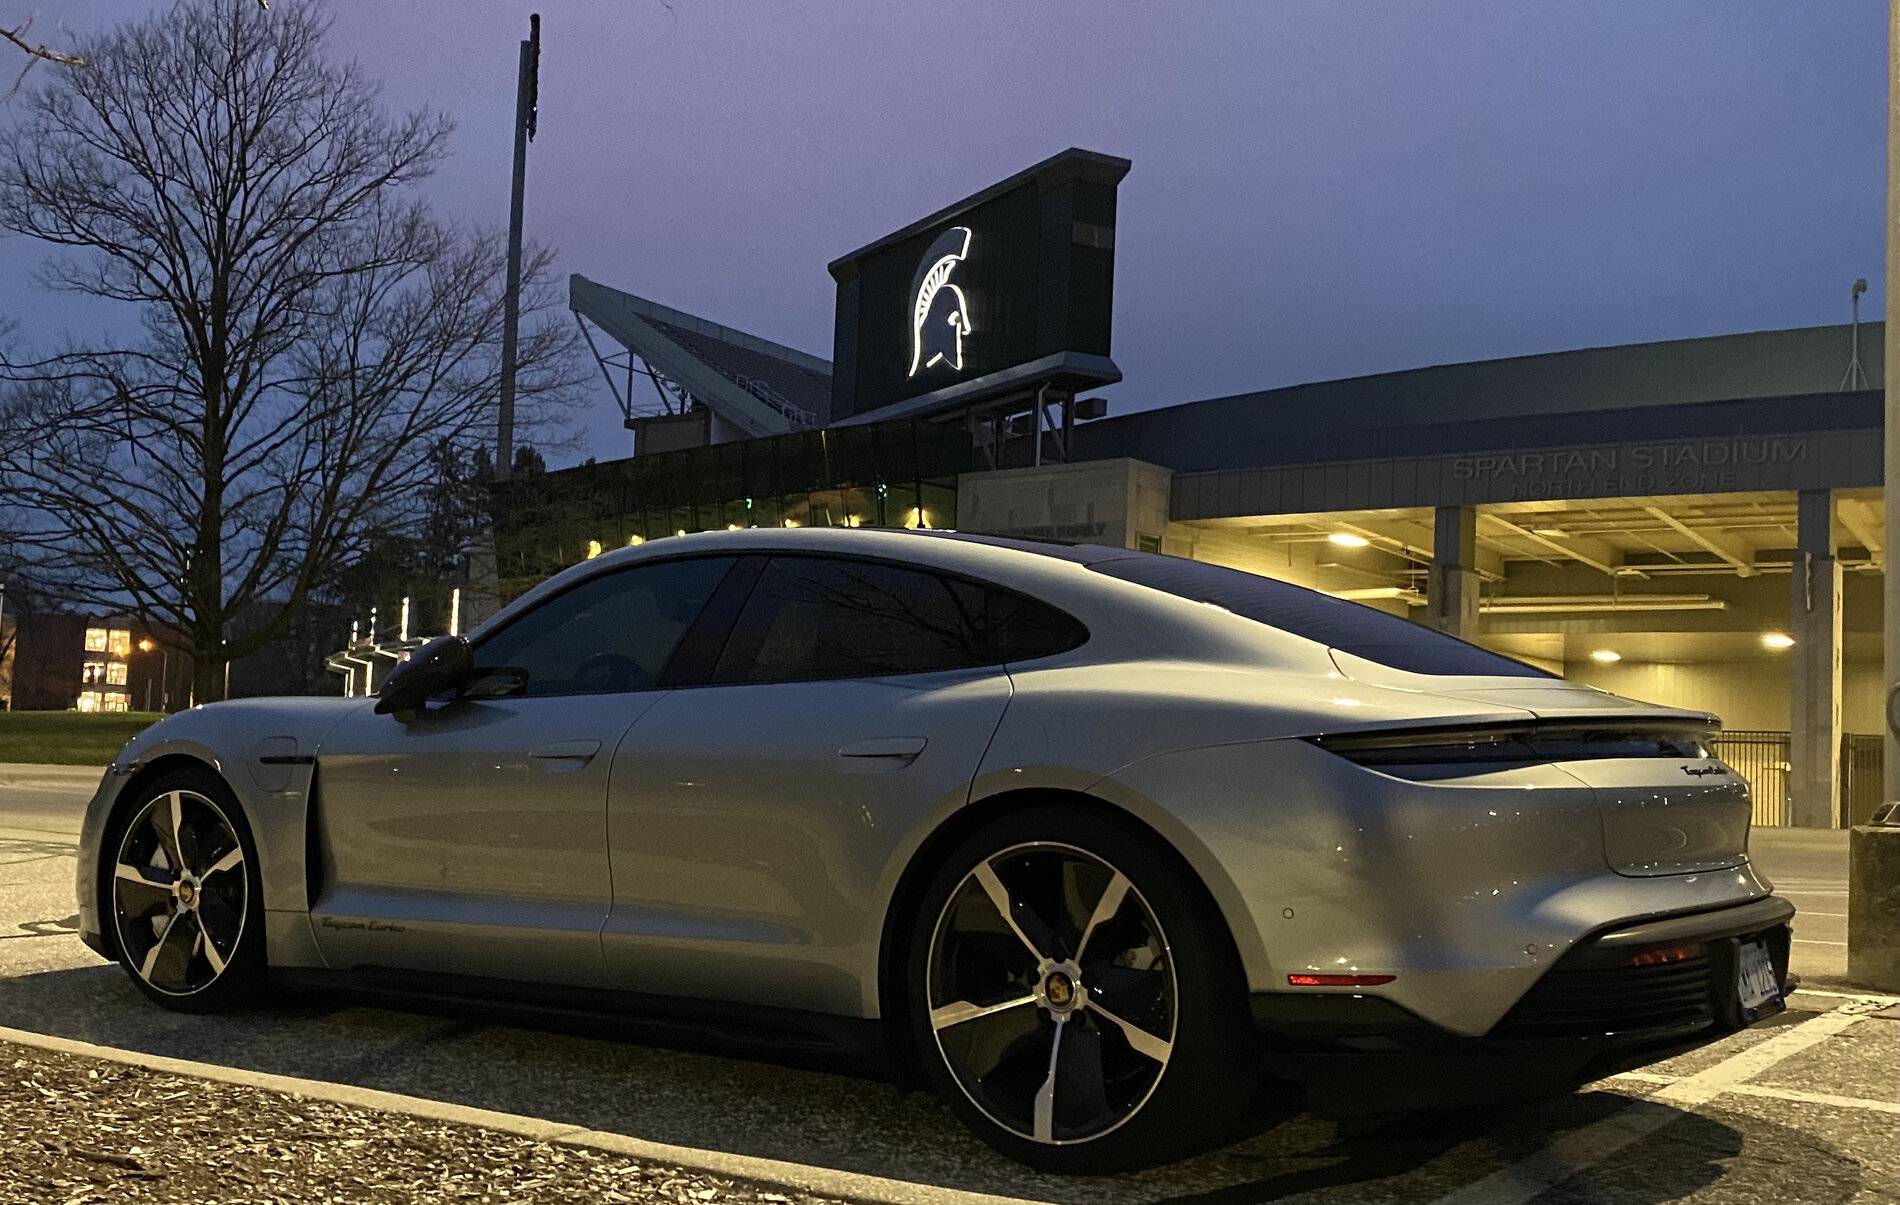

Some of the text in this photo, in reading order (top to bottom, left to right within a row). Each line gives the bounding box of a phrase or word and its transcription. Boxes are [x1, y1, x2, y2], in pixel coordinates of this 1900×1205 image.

[1453, 438, 1808, 479] SPARTAN STADIUM
[1512, 471, 1736, 497] NORTH END ZONE
